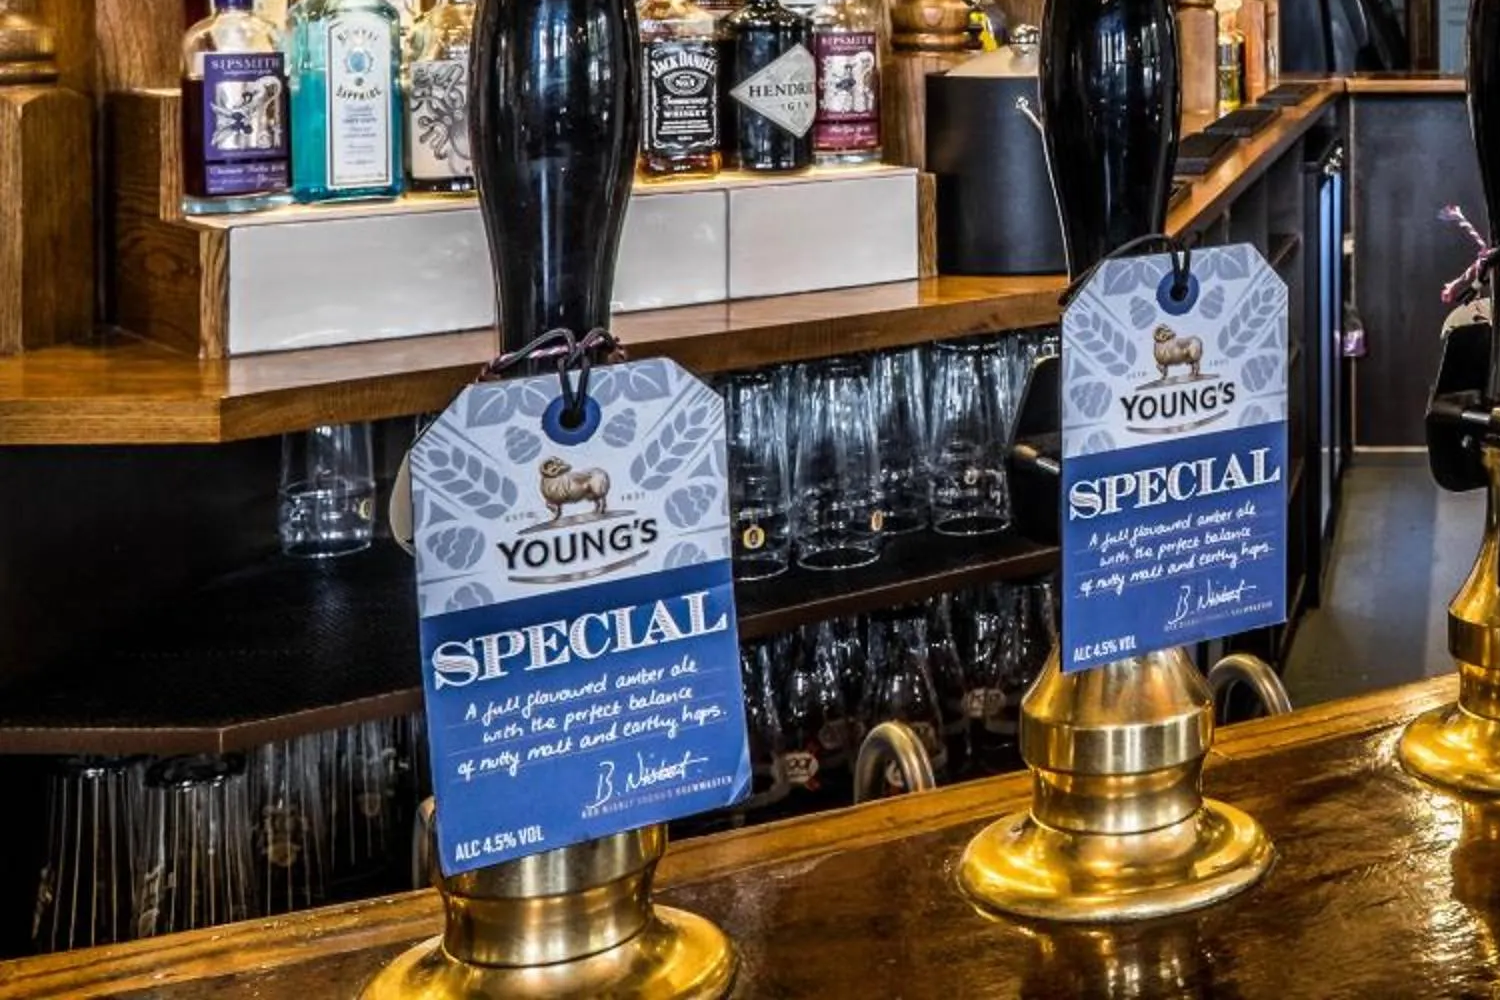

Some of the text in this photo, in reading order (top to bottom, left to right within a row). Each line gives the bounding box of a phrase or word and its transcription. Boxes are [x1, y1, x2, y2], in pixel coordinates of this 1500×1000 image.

[651, 55, 679, 79] JACK
[1120, 382, 1235, 421] YOUNG'S
[1069, 447, 1281, 520] SPECIAL
[496, 518, 658, 570] YOUNG'S
[1088, 532, 1099, 550] A
[1101, 531, 1129, 554] full
[1235, 500, 1256, 517] ale
[1100, 527, 1251, 567] with the perfect balance
[1096, 573, 1125, 596] nutty
[1129, 564, 1163, 581] malt
[1167, 553, 1195, 574] and
[1198, 548, 1238, 569] earthy
[431, 590, 728, 690] SPECIAL
[1073, 645, 1092, 663] ALC
[1119, 634, 1137, 651] VOL
[464, 702, 477, 721] A
[482, 695, 520, 727] full
[615, 667, 664, 689] amber
[671, 654, 697, 677] ale
[483, 687, 693, 743] with the perfect balance
[457, 760, 476, 780] of
[480, 751, 520, 777] nutty
[527, 736, 573, 760] malt
[579, 721, 618, 748] and
[623, 714, 680, 739] earthy
[454, 824, 546, 863] ALC 4.5% VOL
